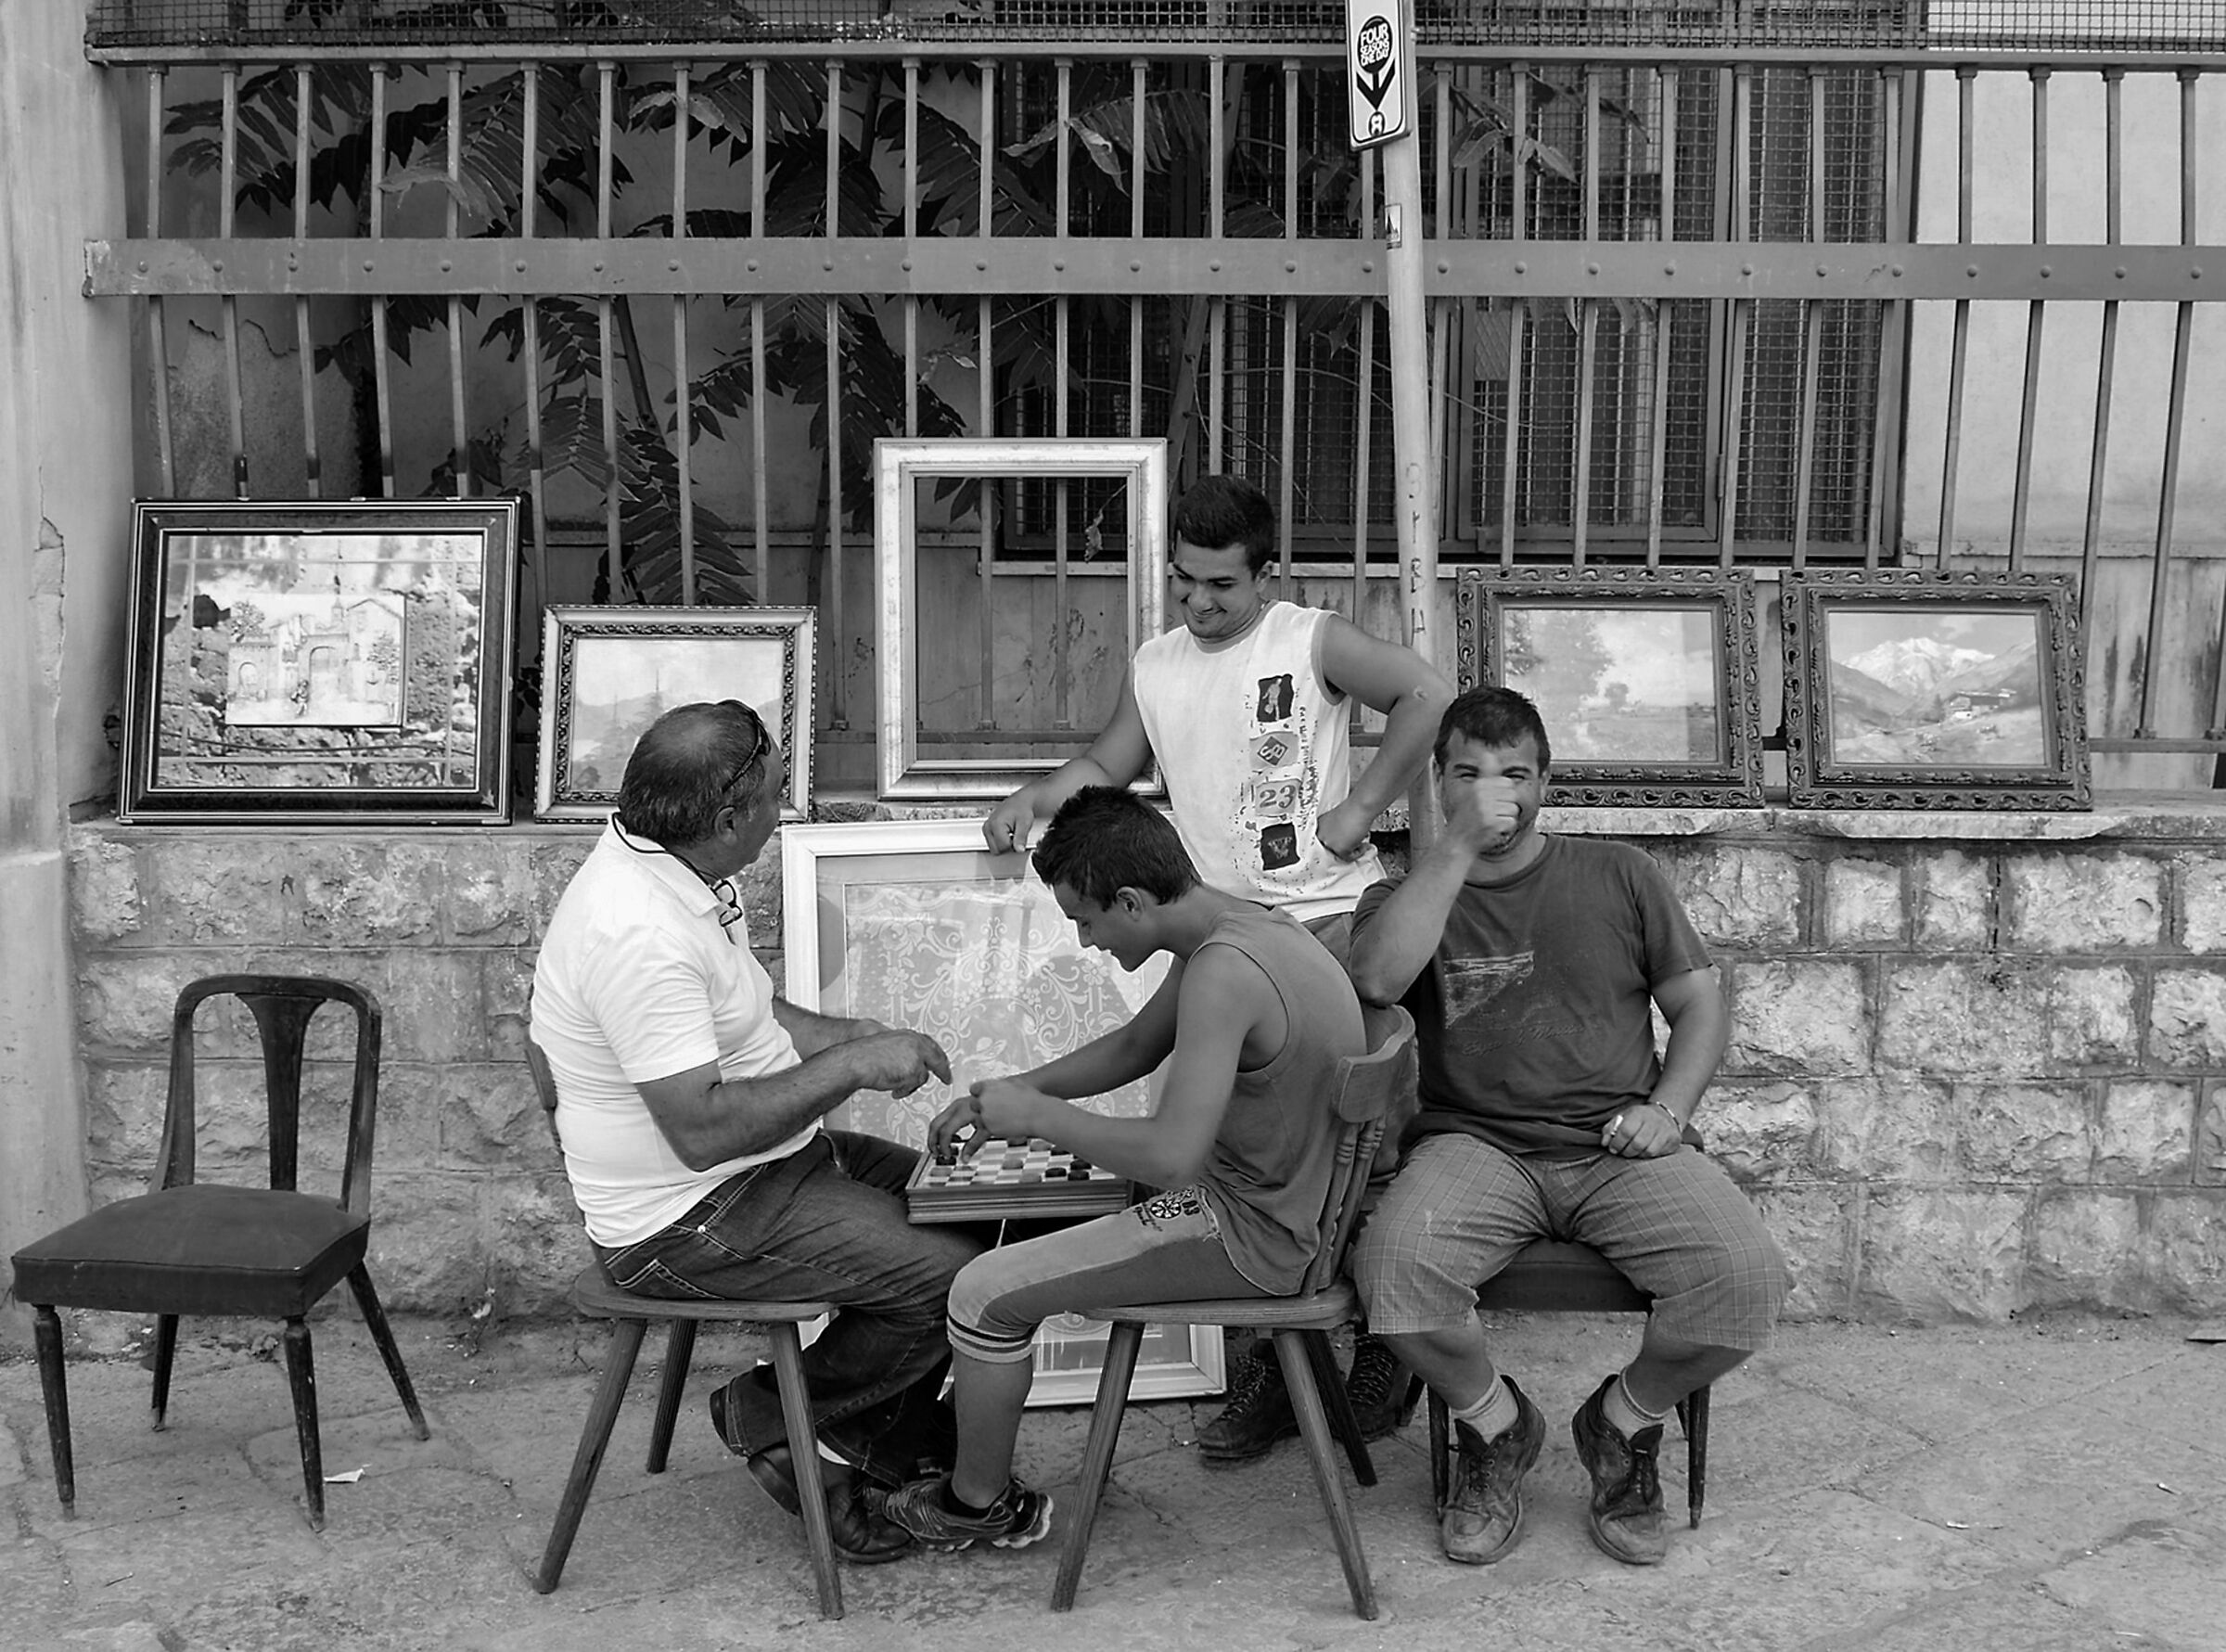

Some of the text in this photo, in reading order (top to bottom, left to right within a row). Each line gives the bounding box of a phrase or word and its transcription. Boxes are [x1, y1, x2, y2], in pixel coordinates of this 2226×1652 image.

[1361, 23, 1388, 46] FOUR
[1361, 40, 1389, 56] SEASONS
[1361, 52, 1375, 67] ONE
[1260, 785, 1296, 809] 23
